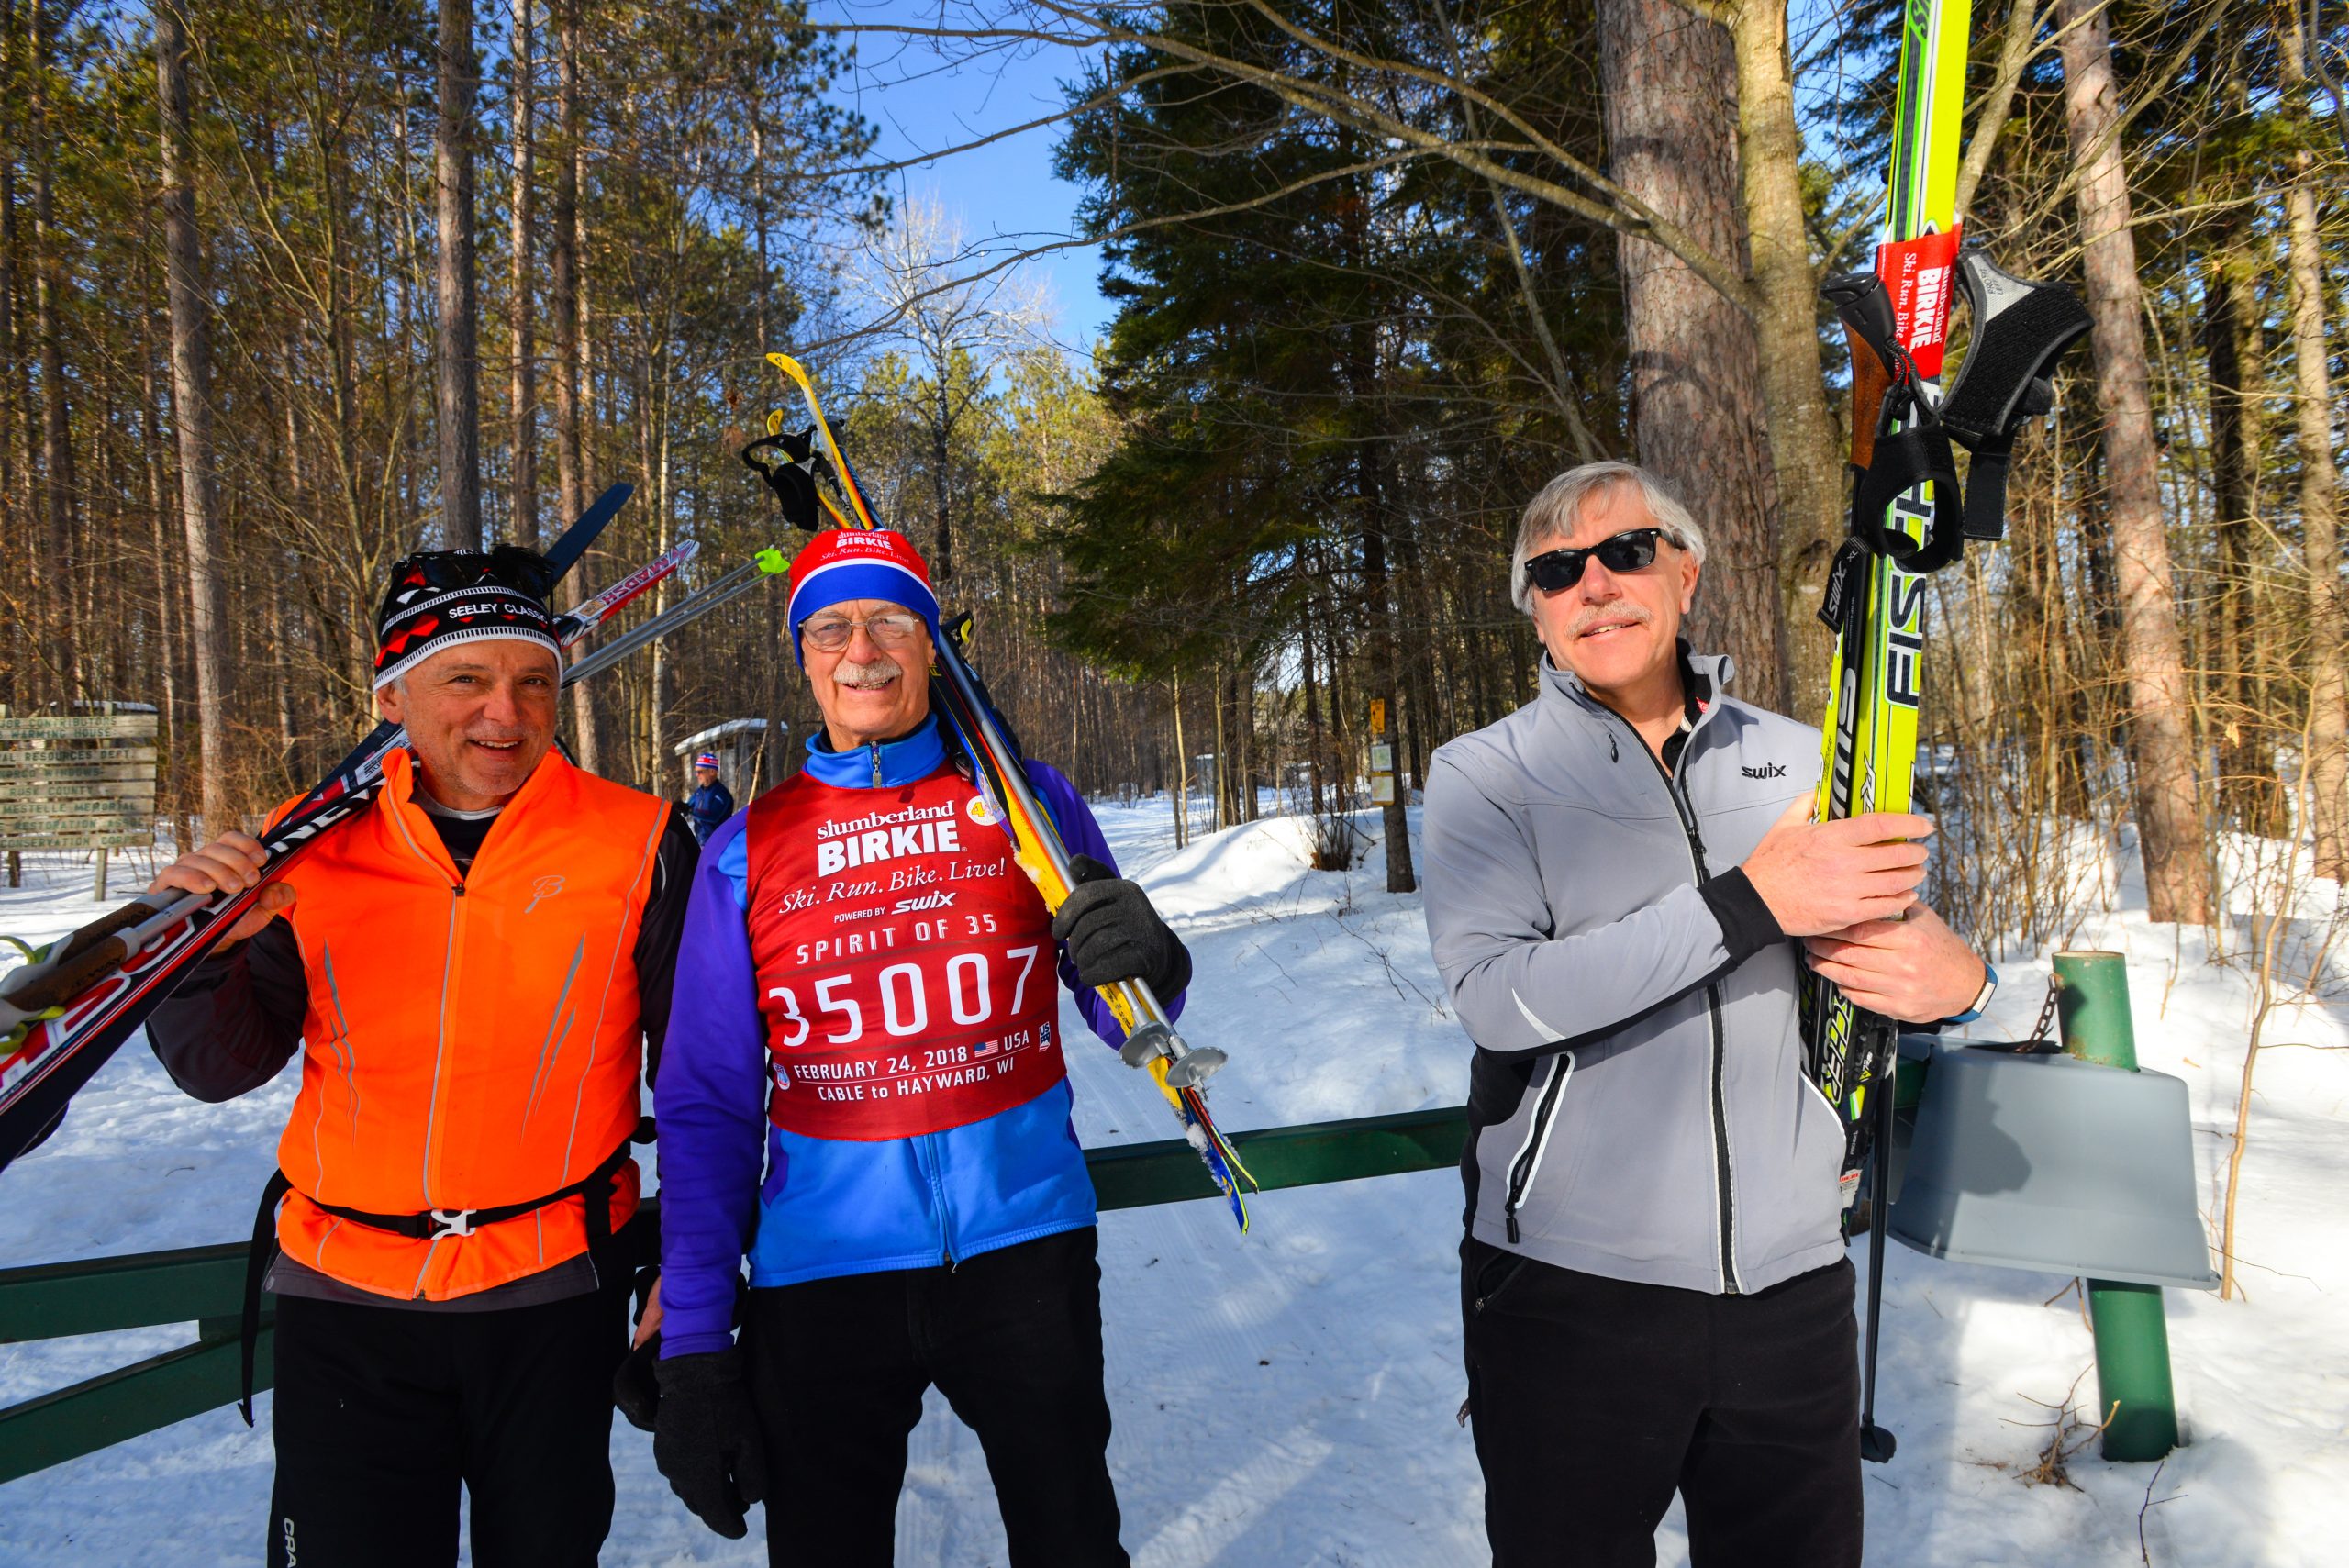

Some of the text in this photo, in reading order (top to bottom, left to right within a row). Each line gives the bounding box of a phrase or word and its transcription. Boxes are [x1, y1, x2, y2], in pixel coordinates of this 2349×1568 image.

[1902, 252, 1917, 279] Ski.
[1898, 279, 1913, 307] Run.
[1932, 264, 1951, 344] slumberland
[1910, 266, 1943, 350] BIRKIE
[836, 537, 893, 550] BIRKIE
[1846, 550, 1859, 562] XL
[449, 604, 498, 619] SEELEY
[11, 728, 66, 739] WARMING
[28, 717, 117, 728] CONTRIBUTORS
[25, 750, 92, 762] RESOURCES
[48, 785, 94, 796] COUNTY
[817, 801, 954, 840] slumberland
[0, 836, 90, 848] CONSERVATION
[818, 820, 961, 877] BIRKIE
[779, 858, 1006, 915] Ski. Run. Bike. Live!
[834, 909, 871, 924] POWERED
[874, 906, 885, 917] BY
[797, 914, 997, 965] SPIRIT OF 35
[768, 945, 1039, 1048] 35007
[794, 1029, 1030, 1081] FEBRUARY 24, 2018 USA
[818, 1058, 1014, 1102] CABLE to HAYWARD, WI
